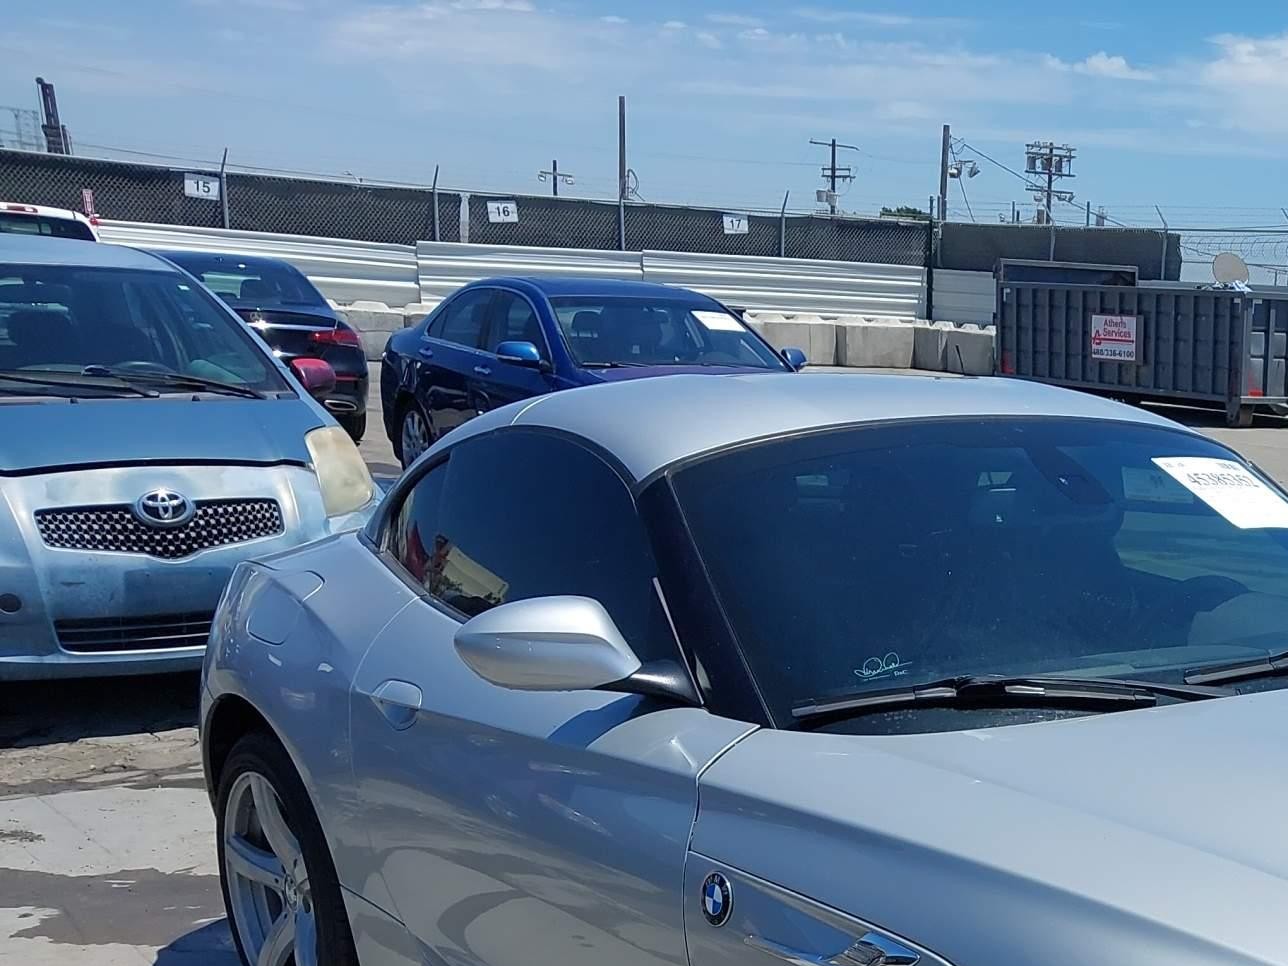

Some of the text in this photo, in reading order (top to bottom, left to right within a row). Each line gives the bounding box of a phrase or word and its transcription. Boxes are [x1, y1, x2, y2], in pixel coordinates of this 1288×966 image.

[194, 180, 211, 193] 15
[495, 205, 511, 217] 16
[730, 218, 742, 229] 17
[1103, 327, 1132, 338] Services
